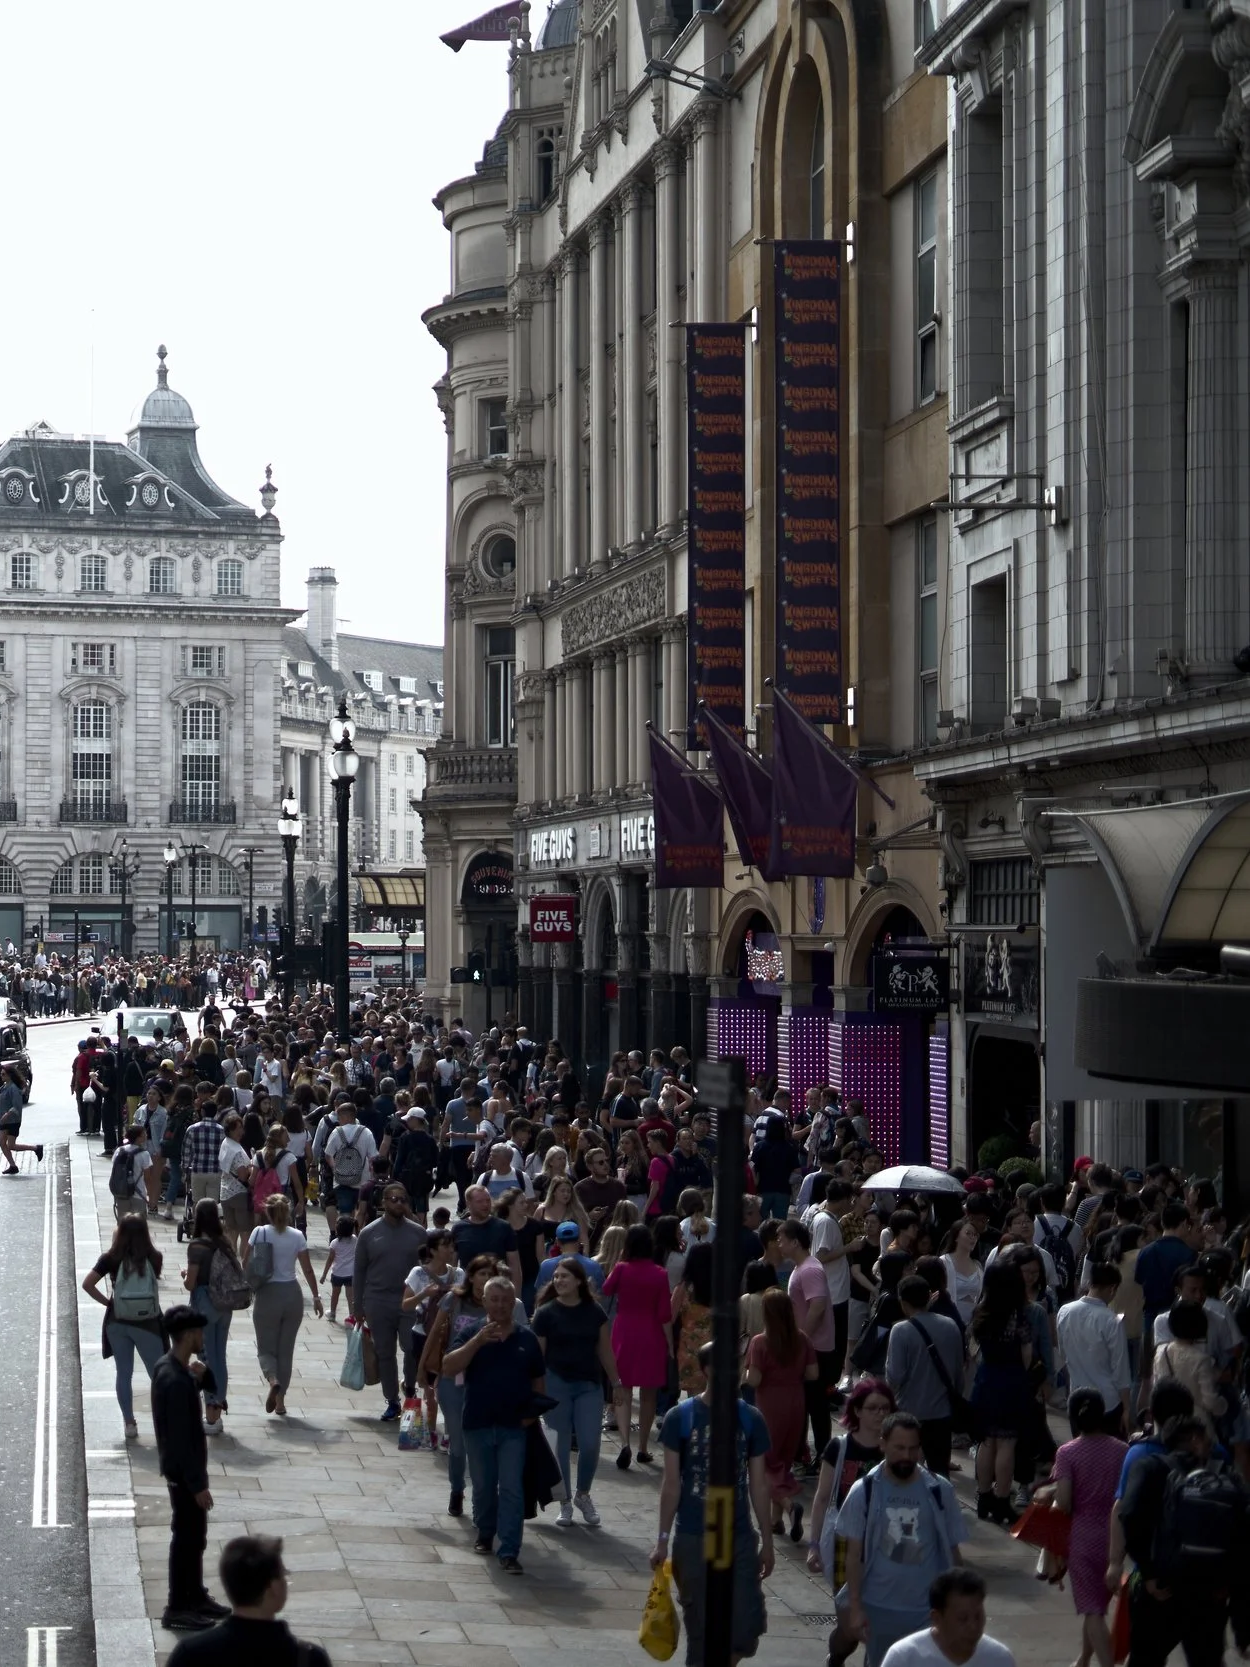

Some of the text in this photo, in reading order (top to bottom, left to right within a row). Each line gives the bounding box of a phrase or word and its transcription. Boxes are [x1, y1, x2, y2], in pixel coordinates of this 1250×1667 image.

[784, 254, 837, 269] KINGDOM
[793, 268, 838, 280] SWEETS
[784, 298, 837, 313] KINGDOM
[793, 312, 838, 324] SWEETS
[695, 335, 742, 348] KINGDOM
[703, 348, 742, 359] SWEETS
[784, 341, 837, 356] KINGDOM
[793, 355, 838, 367] SWEETS
[695, 374, 742, 387] KINGDOM
[703, 387, 742, 398] SWEETS
[784, 385, 837, 400] KINGDOM
[793, 399, 838, 411] SWEETS
[695, 412, 742, 425] KINGDOM
[703, 425, 742, 436] SWEETS
[784, 429, 837, 444] KINGDOM
[793, 443, 838, 455] SWEETS
[695, 451, 742, 464] KINGDOM
[703, 464, 742, 475] SWEETS
[785, 473, 838, 488] KINGDOM
[695, 489, 742, 502] KINGDOM
[794, 487, 838, 499] SWEETS
[703, 502, 742, 513] SWEETS
[785, 517, 838, 532] KINGDOM
[696, 529, 742, 542] KINGDOM
[794, 531, 838, 543] SWEETS
[704, 542, 742, 553] SWEETS
[696, 567, 742, 580] KINGDOM
[785, 561, 838, 576] KINGDOM
[704, 580, 742, 591] SWEETS
[794, 575, 838, 587] SWEETS
[696, 606, 742, 619] KINGDOM
[785, 605, 838, 620] KINGDOM
[704, 619, 742, 630] SWEETS
[794, 619, 838, 631] SWEETS
[696, 645, 742, 658] KINGDOM
[785, 649, 838, 664] KINGDOM
[704, 658, 742, 669] SWEETS
[794, 663, 839, 675] SWEETS
[696, 683, 742, 697] KINGDOM
[802, 706, 839, 718] WEETS
[621, 817, 646, 852] FIVE
[781, 825, 849, 843] KINGDOM
[531, 831, 549, 863] FIVE
[550, 827, 574, 861] GUYS
[793, 843, 852, 857] SWEETS
[537, 911, 568, 921] FIVE
[533, 922, 572, 932] GUYS
[981, 1000, 1016, 1014] PLATINUM LACE
